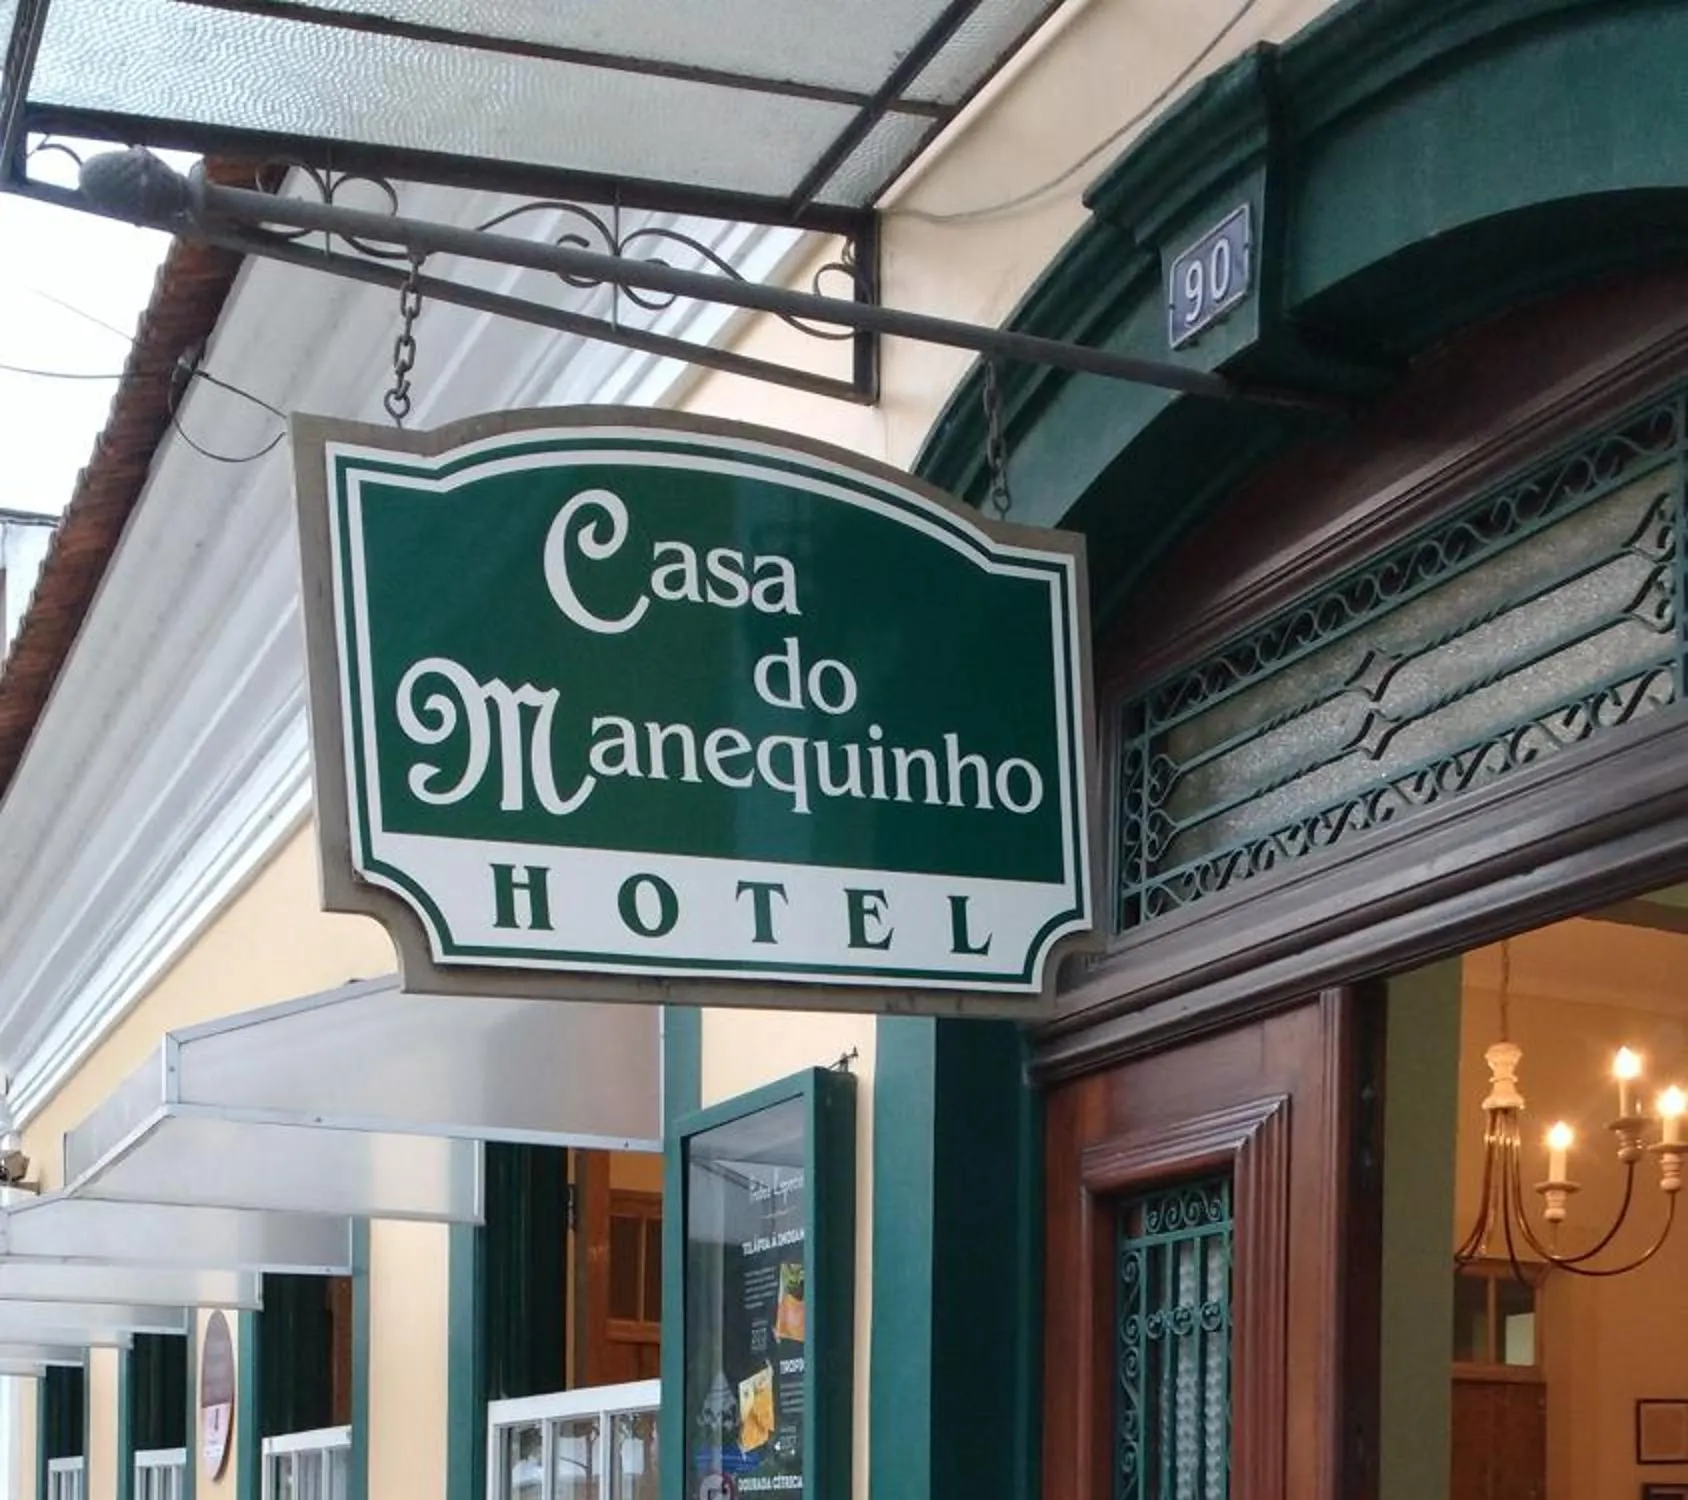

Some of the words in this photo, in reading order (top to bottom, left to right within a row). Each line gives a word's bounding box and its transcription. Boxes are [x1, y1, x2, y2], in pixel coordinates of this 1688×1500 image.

[1184, 237, 1231, 325] 90
[543, 488, 803, 634] Casa
[752, 636, 858, 716] do
[394, 656, 1044, 816] Manequinho
[489, 862, 993, 957] HOTEL
